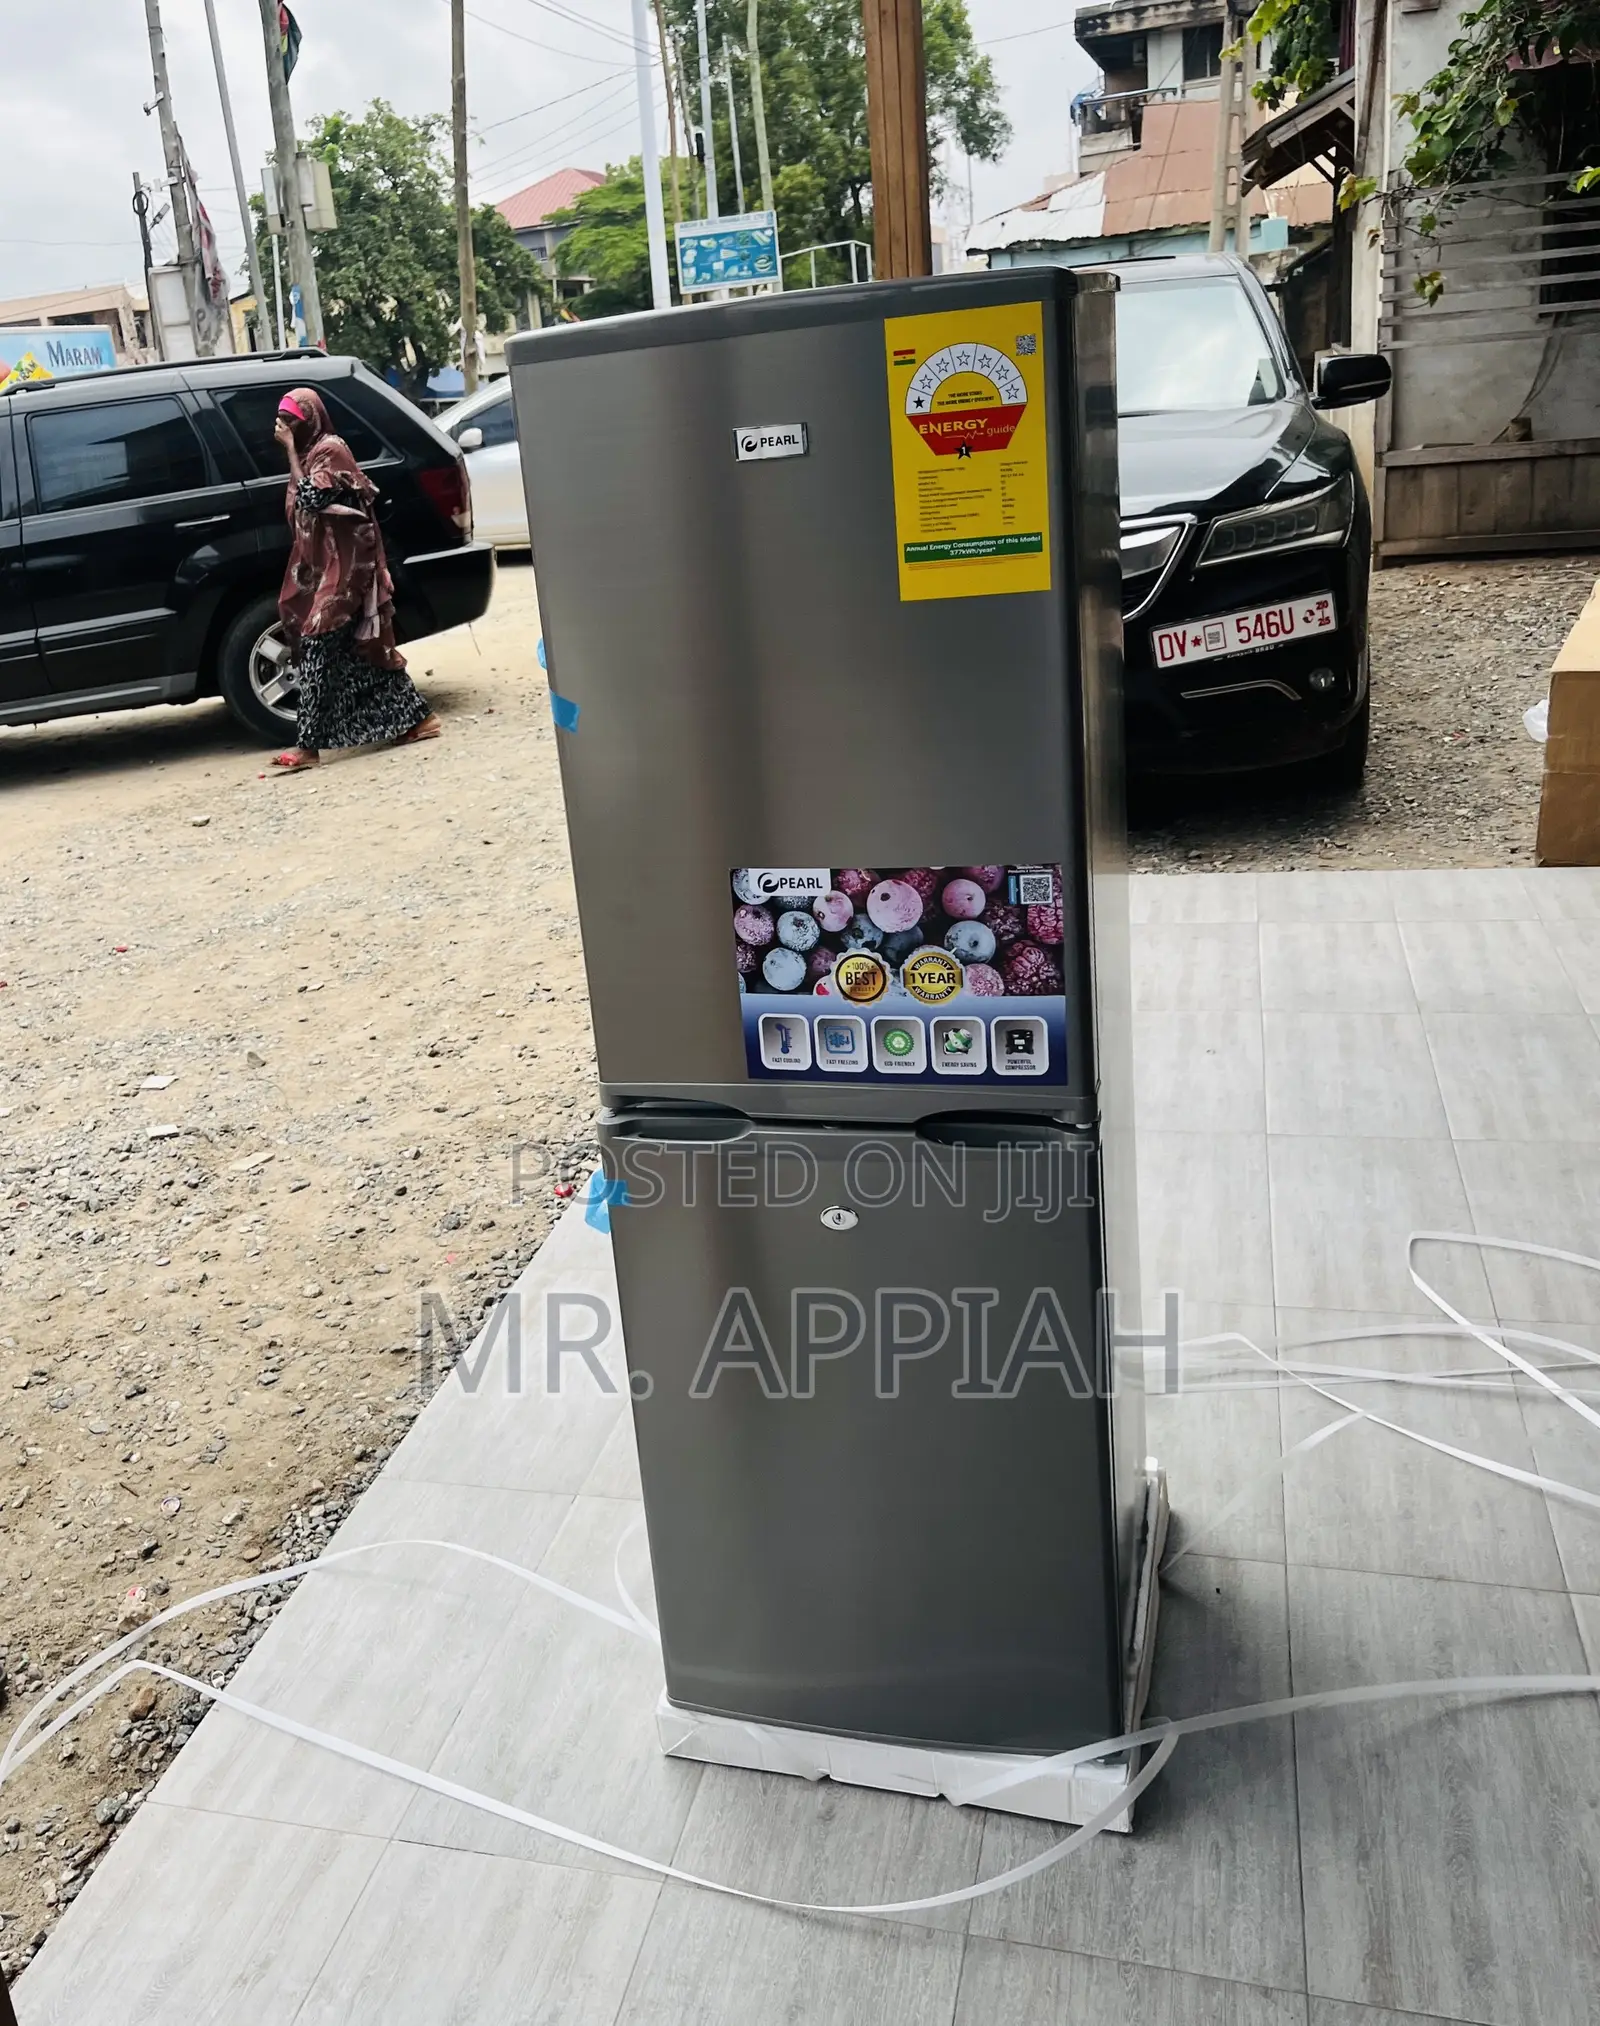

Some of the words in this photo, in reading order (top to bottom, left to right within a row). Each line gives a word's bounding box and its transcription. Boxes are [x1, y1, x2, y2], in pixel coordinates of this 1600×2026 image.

[919, 418, 988, 436] ENERGY
[986, 424, 1016, 436] guide
[760, 434, 799, 448] PEARL
[961, 446, 966, 455] 1
[930, 543, 952, 551] Energy
[953, 540, 997, 549] Consumption
[1236, 607, 1295, 645] 546U
[779, 877, 823, 889] PEARL
[852, 962, 870, 971] 100%
[913, 957, 952, 970] WARRANTY
[845, 972, 877, 986] BEST
[909, 973, 916, 984] 1
[918, 972, 956, 984] YEAR
[914, 986, 953, 1000] WARRANTY
